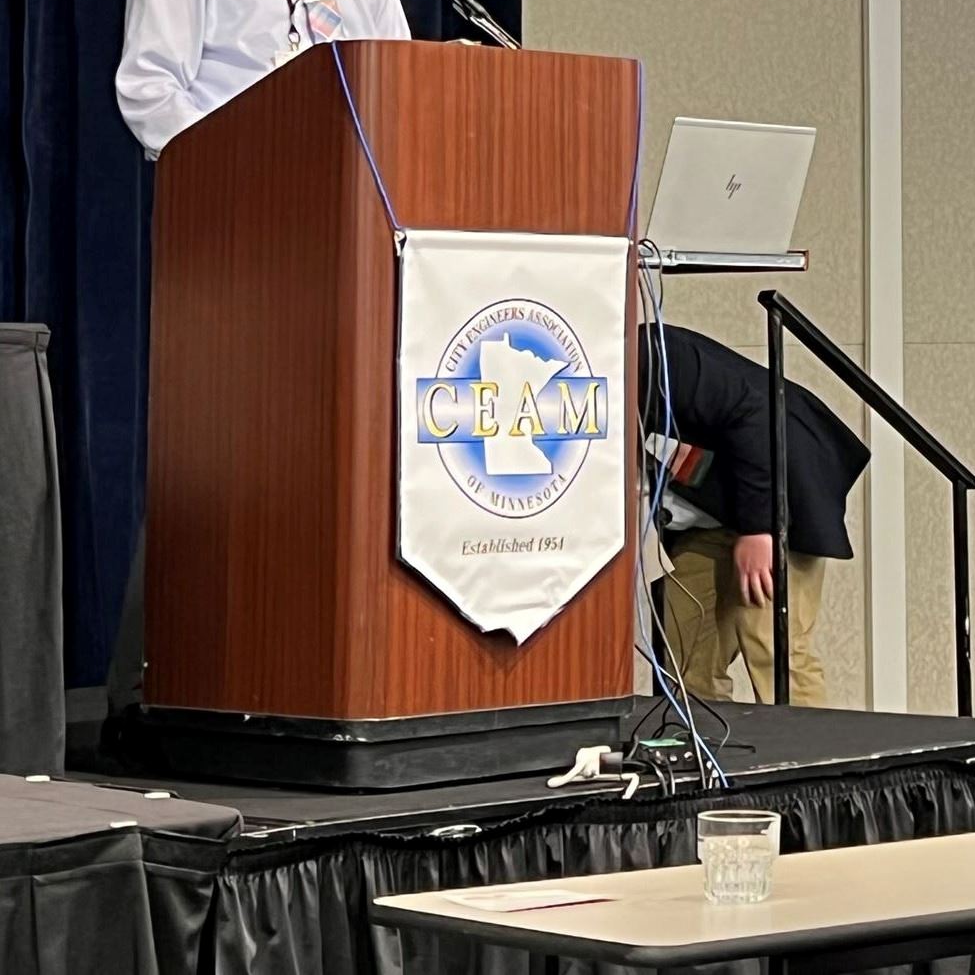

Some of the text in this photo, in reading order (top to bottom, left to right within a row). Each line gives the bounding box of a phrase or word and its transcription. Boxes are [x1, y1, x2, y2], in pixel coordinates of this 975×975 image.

[725, 173, 742, 200] hp
[445, 306, 584, 373] CITY ENGINEERS ASSOCIATION
[422, 380, 602, 439] CEAM
[467, 473, 568, 512] OF MINNESOTA
[461, 536, 565, 556] Established 1951
